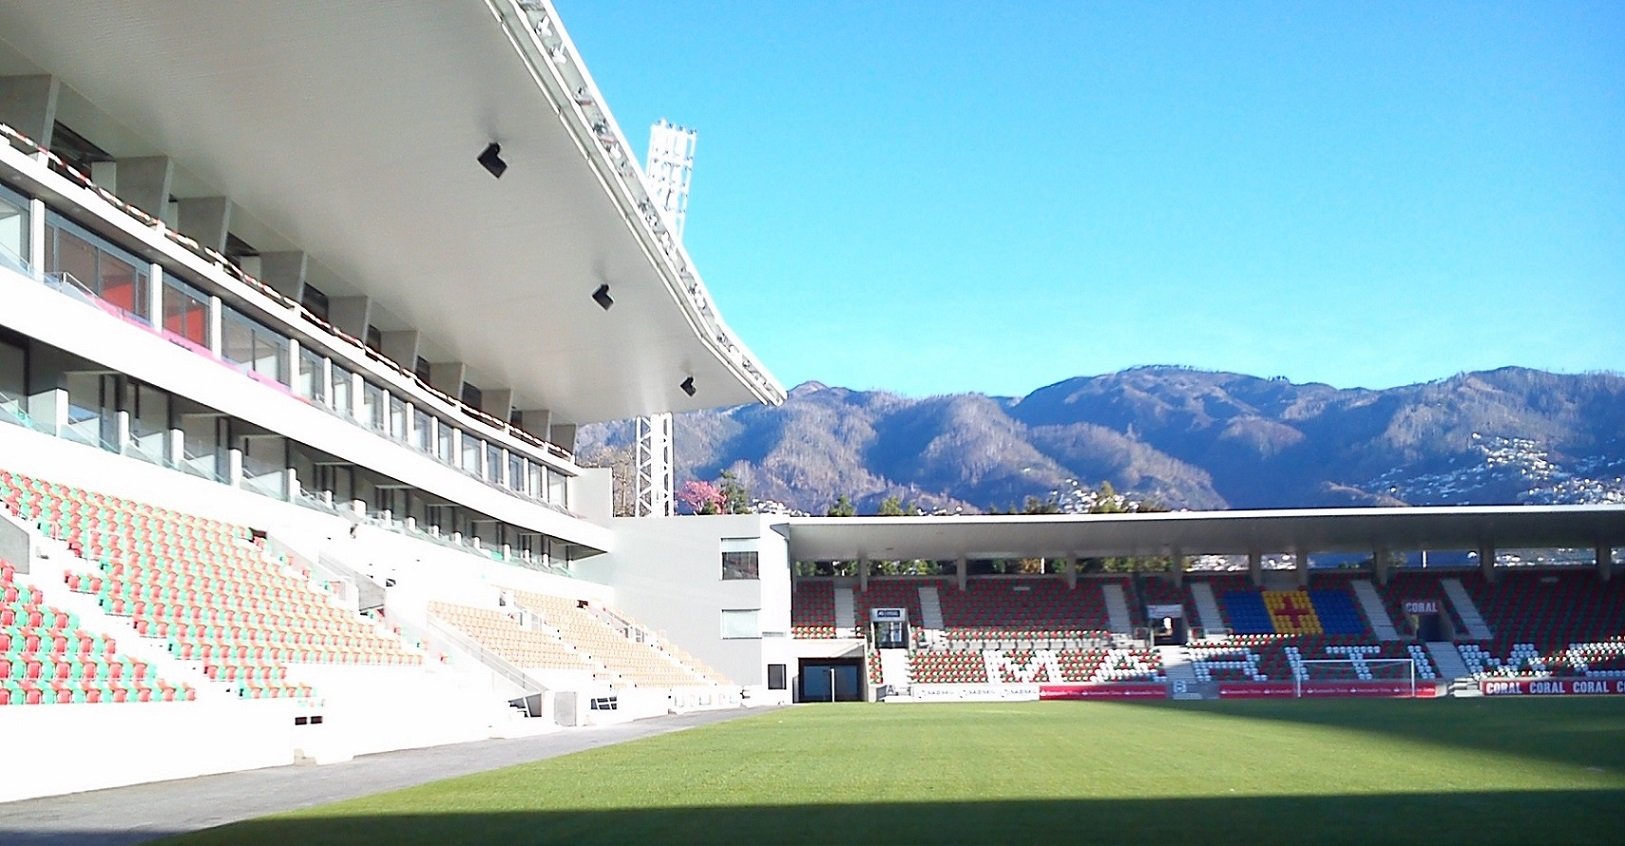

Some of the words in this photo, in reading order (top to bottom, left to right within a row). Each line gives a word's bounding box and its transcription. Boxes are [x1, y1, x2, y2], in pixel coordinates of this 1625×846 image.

[1405, 602, 1438, 613] CORAL
[1485, 681, 1522, 694] CORAL
[1529, 681, 1566, 694] CORAL
[1572, 680, 1610, 693] CORAL
